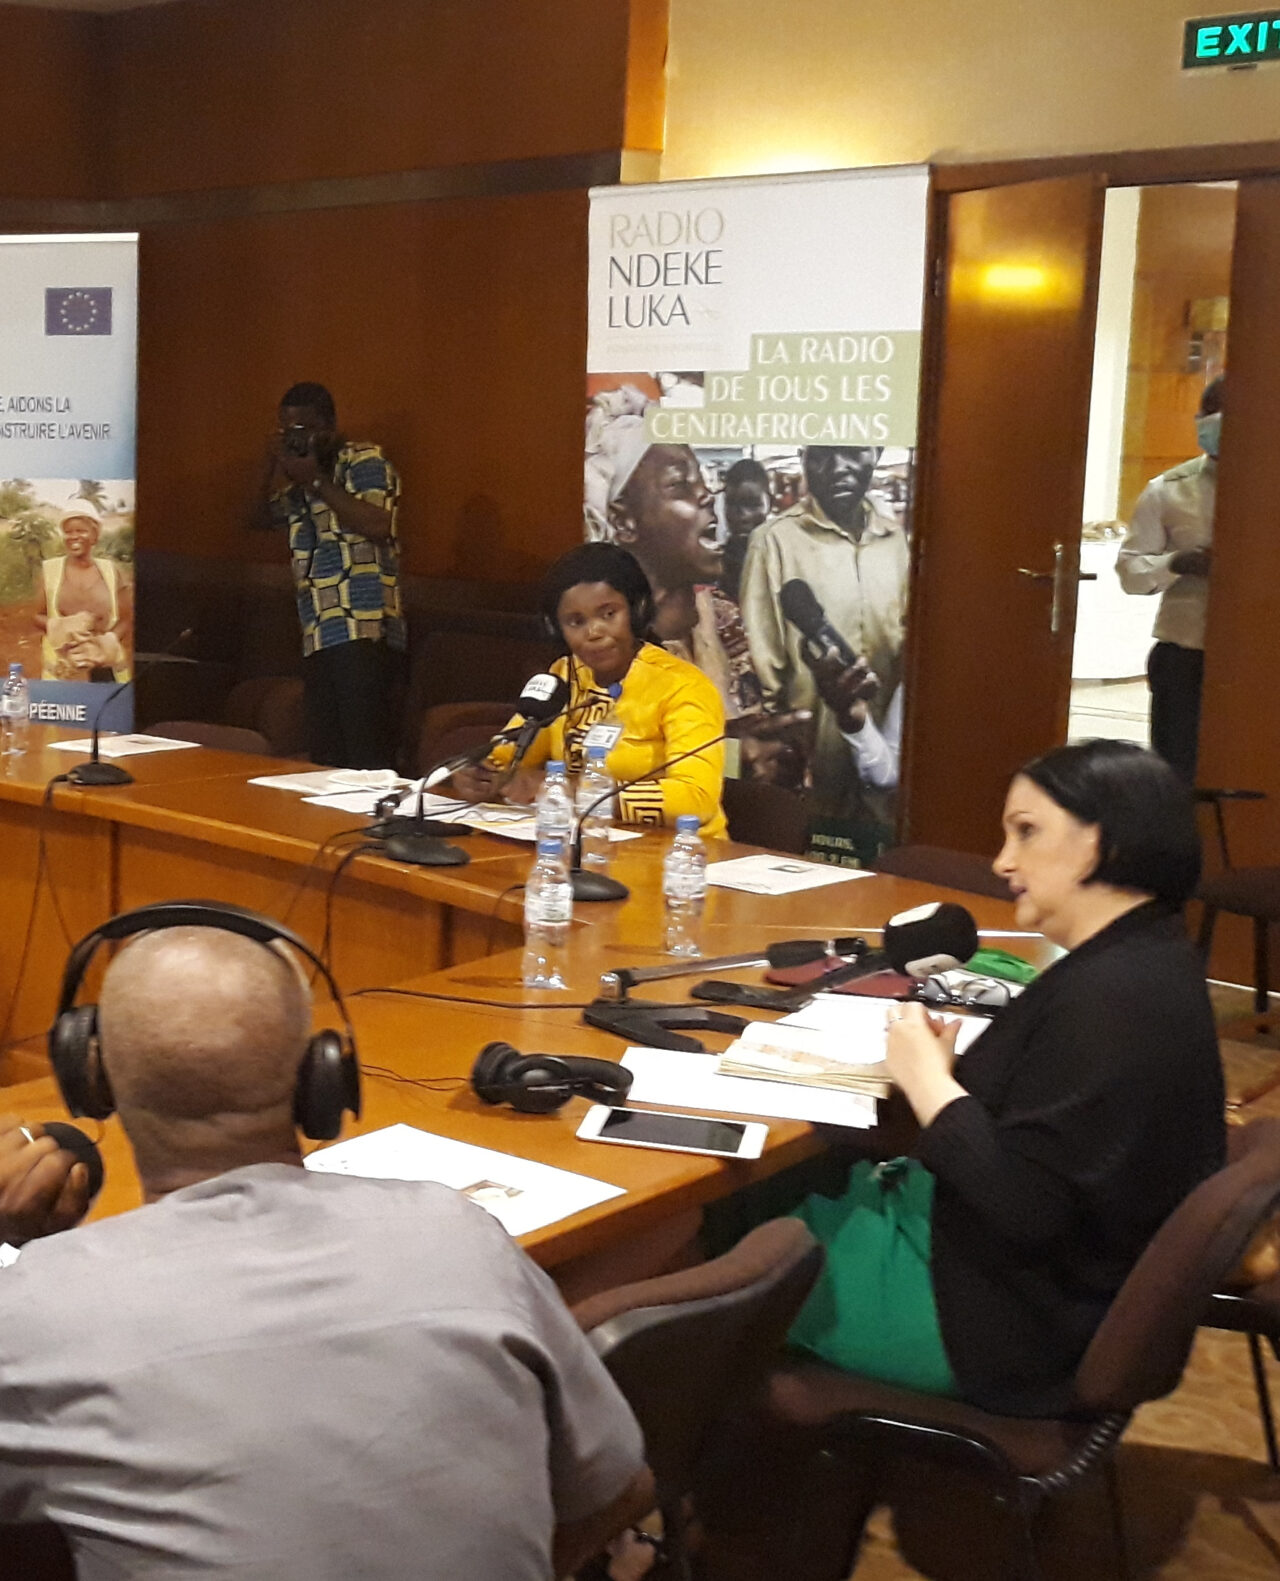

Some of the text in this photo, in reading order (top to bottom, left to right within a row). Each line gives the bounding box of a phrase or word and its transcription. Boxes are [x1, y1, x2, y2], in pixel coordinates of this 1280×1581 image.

[609, 207, 725, 249] RADIO
[608, 249, 723, 289] NDEKE
[607, 293, 691, 329] LUKA
[756, 338, 791, 365] LA
[800, 335, 895, 364] RADIO
[711, 374, 891, 402] DE TOUS LES
[7, 396, 53, 413] AIDONS
[55, 397, 72, 413] LA
[58, 423, 111, 440] L'AVENIR
[651, 412, 890, 441] CENTRAFRICAINS
